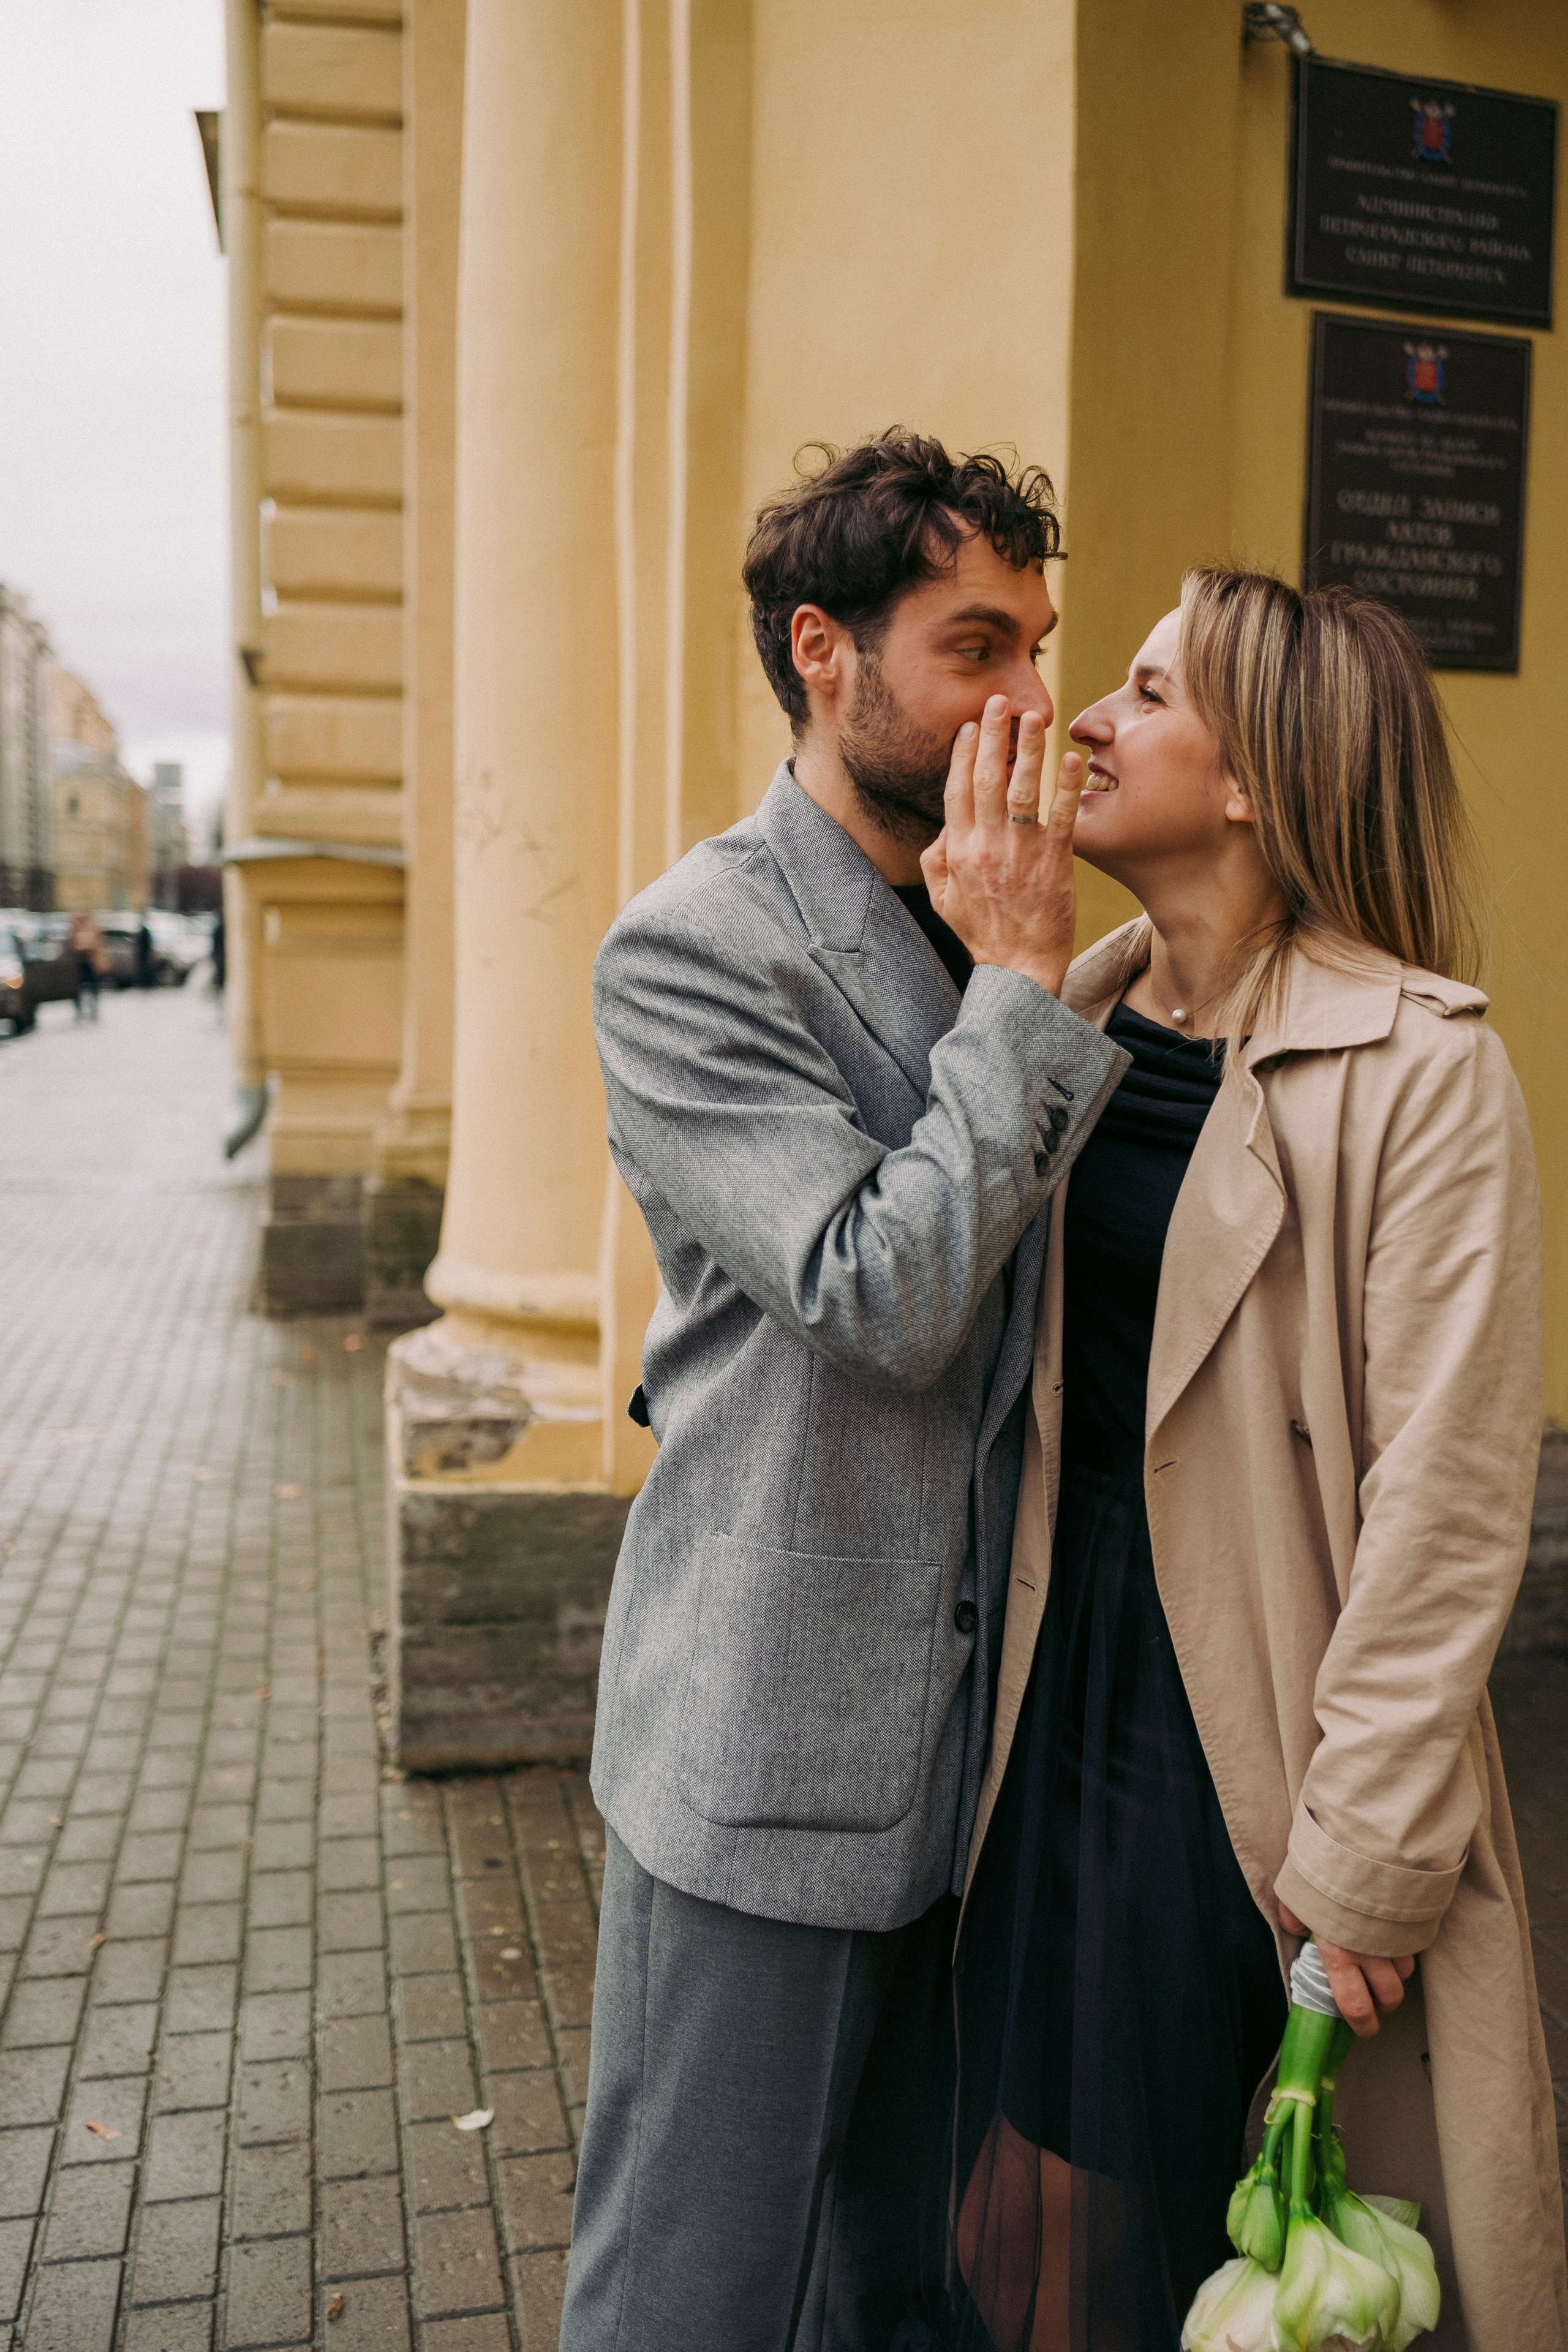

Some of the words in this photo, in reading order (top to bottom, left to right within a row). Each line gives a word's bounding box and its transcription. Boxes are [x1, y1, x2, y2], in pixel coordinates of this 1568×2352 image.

[1337, 488, 1410, 518] ОТДЕЛ
[1418, 496, 1501, 526] ЗАПИСИ
[1385, 520, 1454, 547] АКТОВ
[1331, 540, 1502, 577] ГРАЖДАНСКОГО
